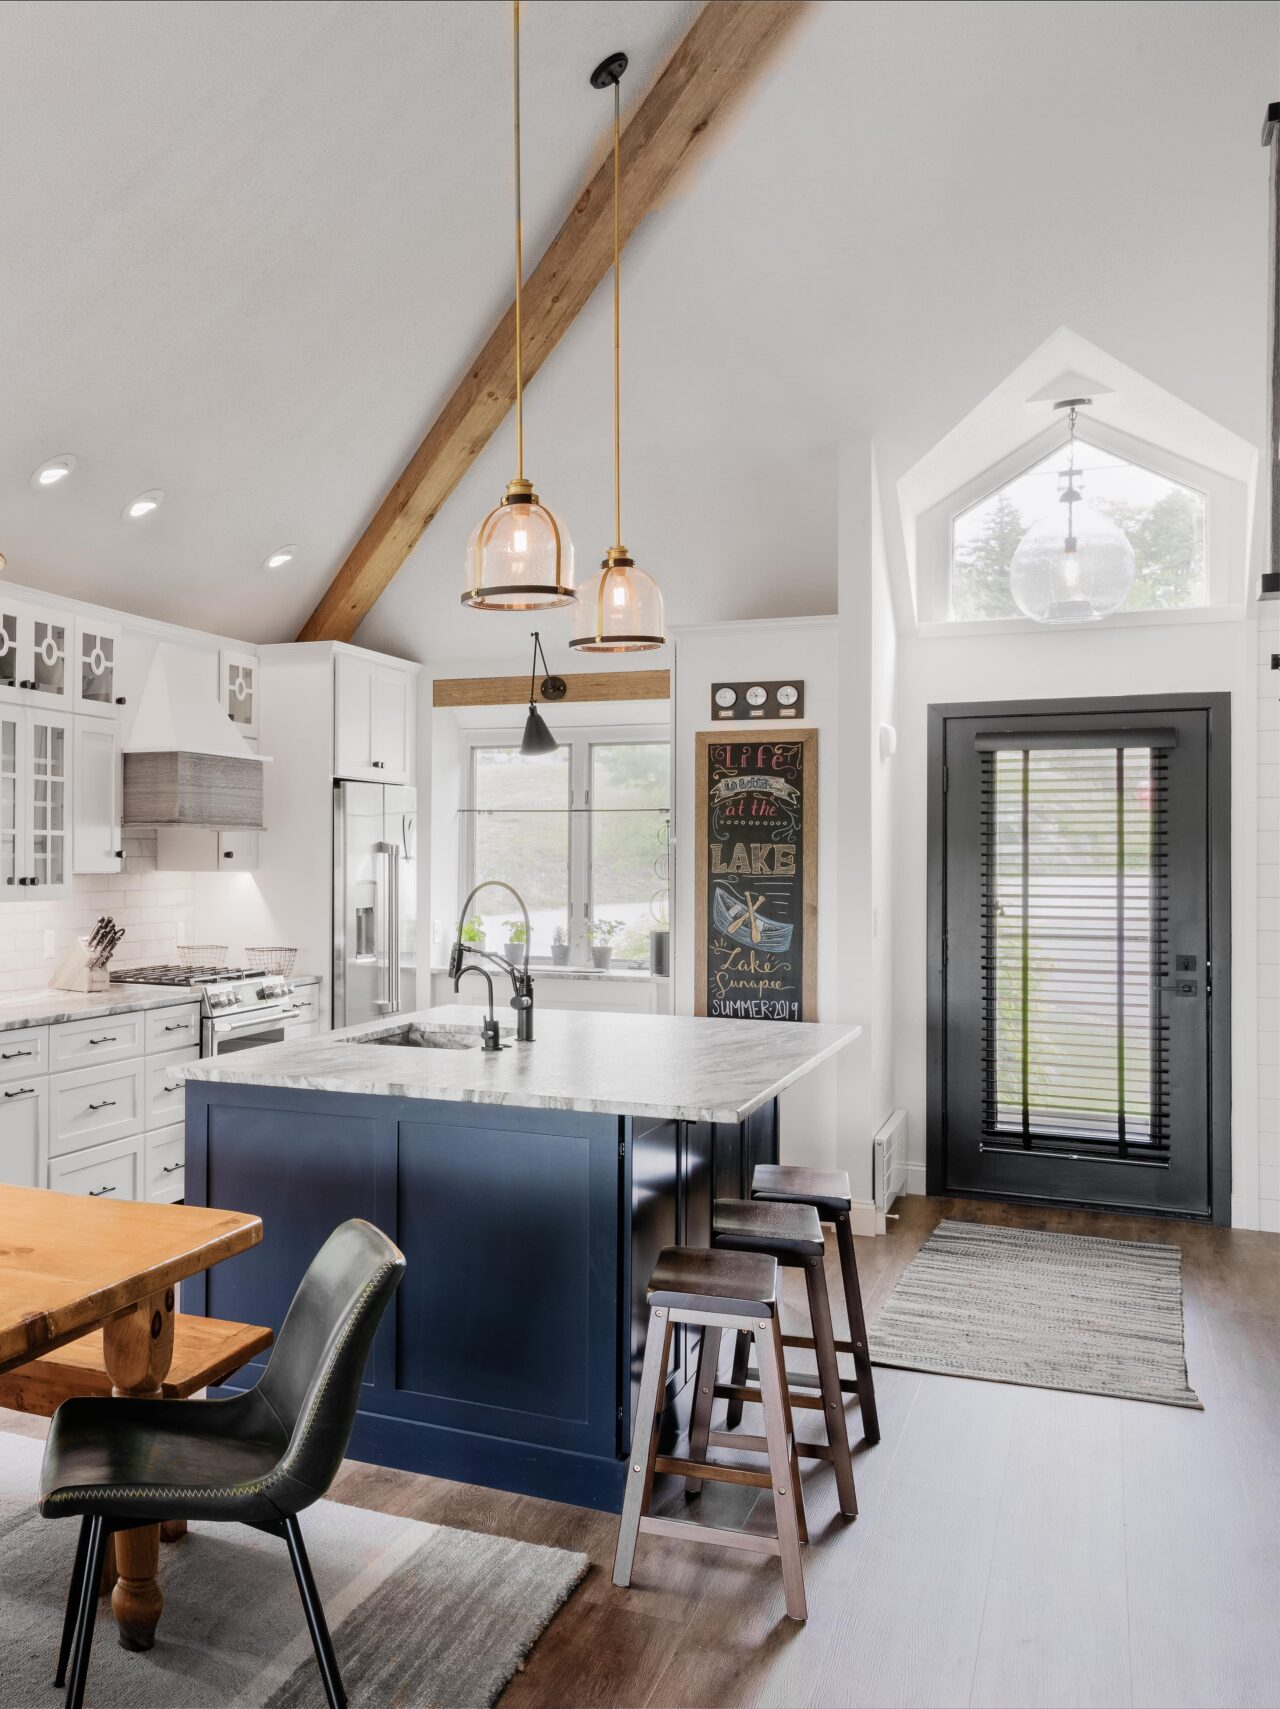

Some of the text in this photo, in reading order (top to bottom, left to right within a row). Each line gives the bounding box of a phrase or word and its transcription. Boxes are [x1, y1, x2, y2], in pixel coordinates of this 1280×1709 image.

[715, 744, 788, 771] Life
[725, 799, 778, 816] at the
[710, 842, 796, 875] LAKE
[715, 947, 791, 974] Lake
[716, 971, 795, 999] Sunapee
